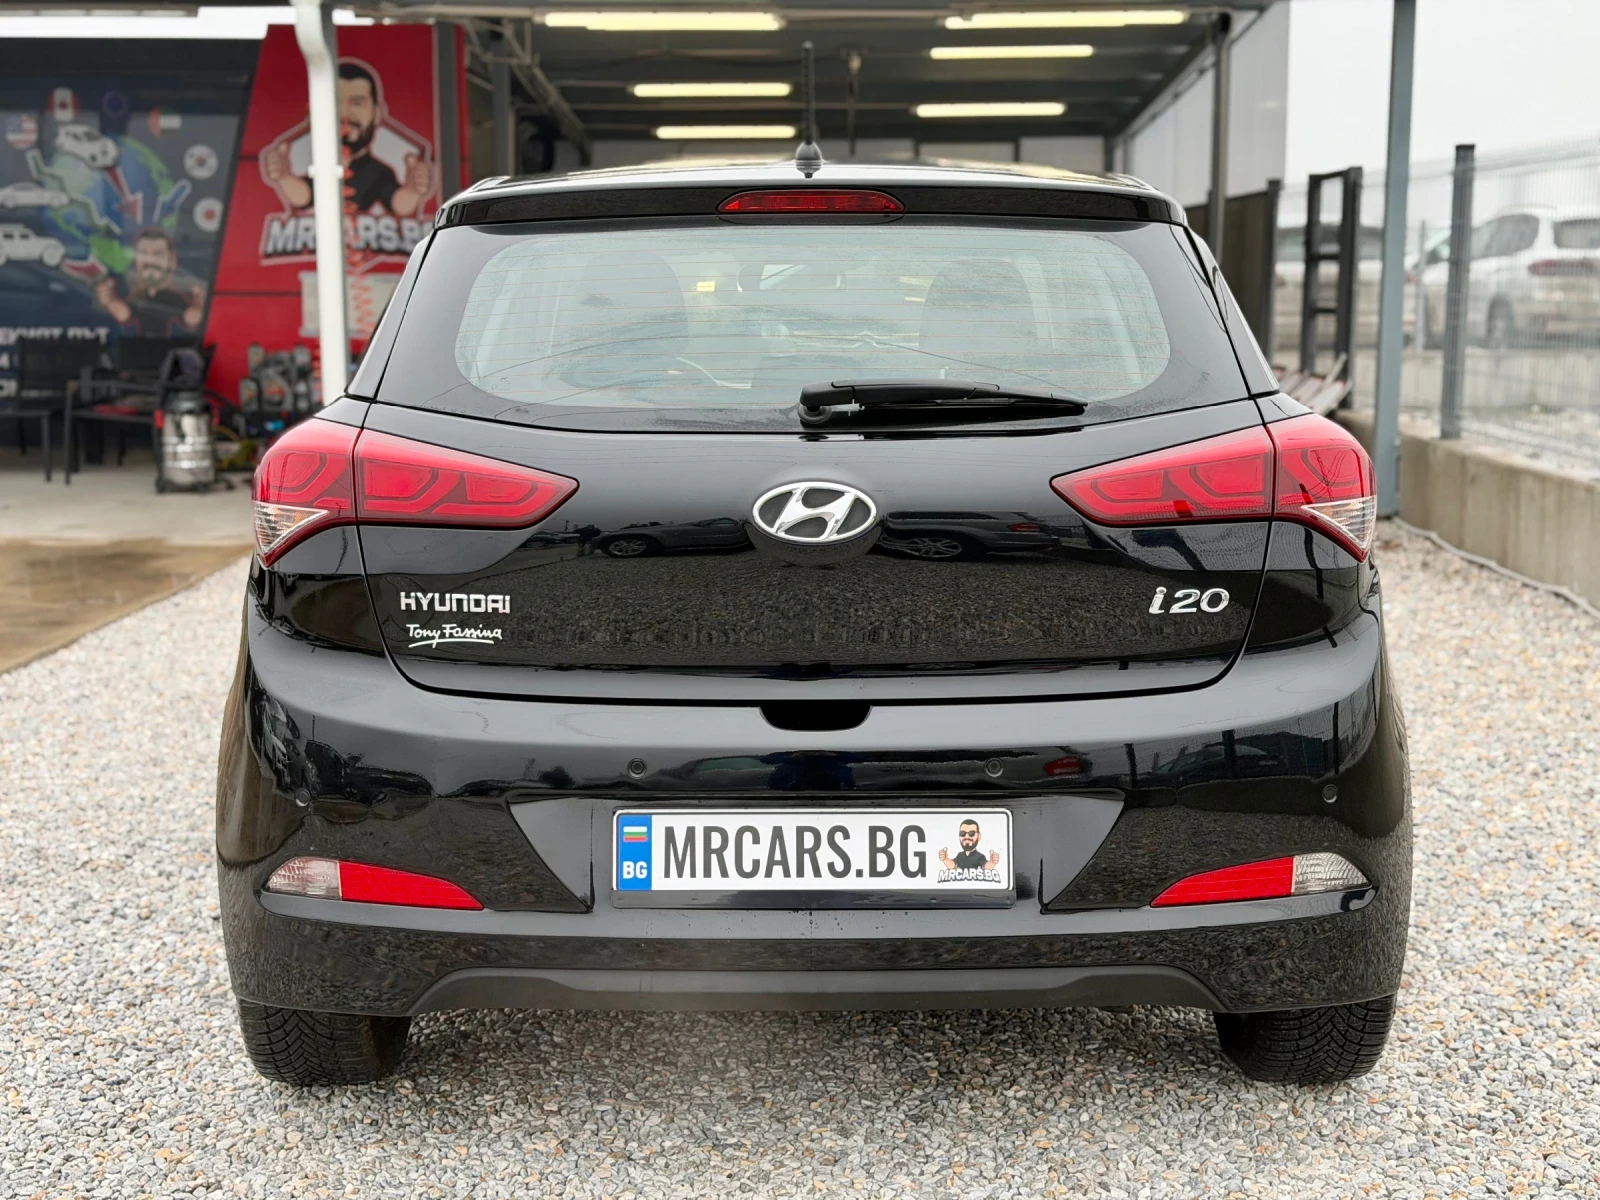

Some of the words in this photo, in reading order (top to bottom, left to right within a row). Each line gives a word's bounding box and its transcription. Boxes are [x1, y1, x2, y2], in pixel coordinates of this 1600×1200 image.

[400, 591, 511, 614] HYUNDAI
[1148, 586, 1230, 615] i20
[406, 623, 442, 648] Tony
[442, 623, 503, 640] Fassina
[663, 824, 927, 880] MRCARS.BG
[622, 860, 648, 879] BG
[937, 868, 1001, 884] MRCARS.BG
